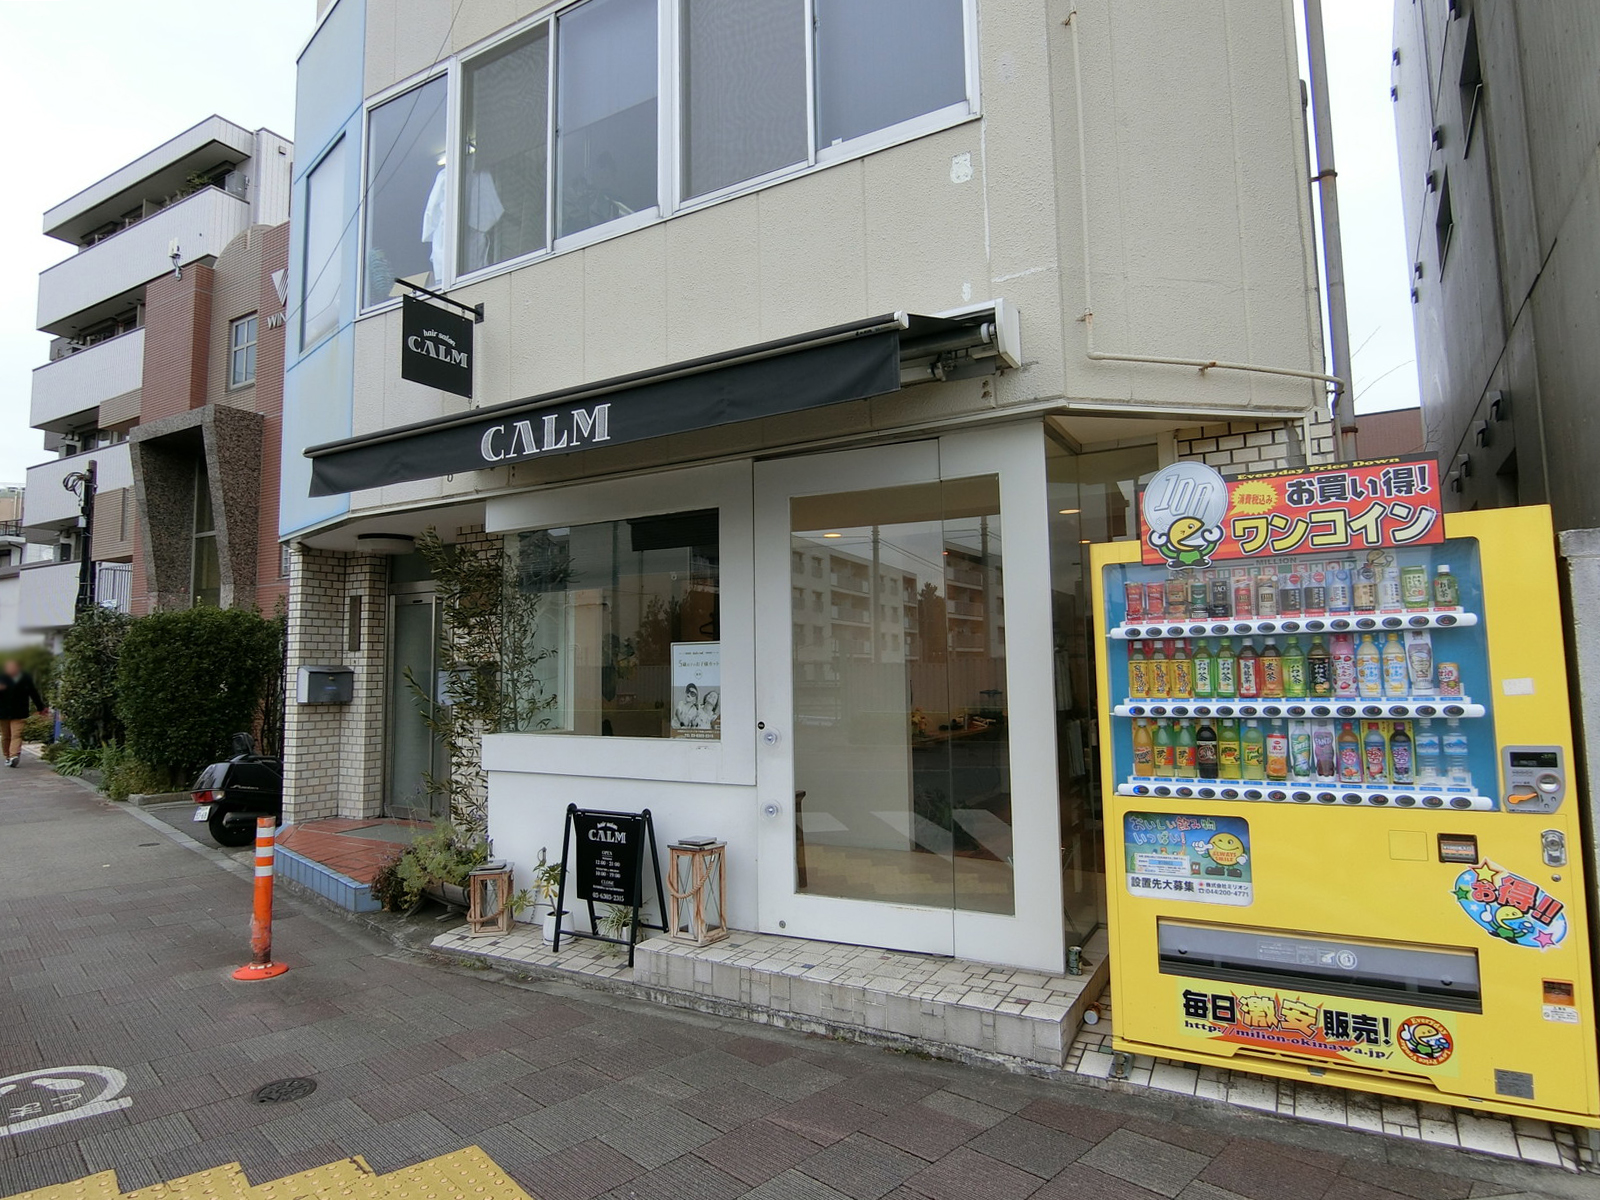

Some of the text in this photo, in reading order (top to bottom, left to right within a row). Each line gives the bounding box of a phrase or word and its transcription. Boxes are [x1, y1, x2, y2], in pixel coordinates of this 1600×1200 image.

[423, 329, 456, 347] hair salon
[407, 335, 468, 369] CALM
[480, 402, 612, 462] CALM
[1237, 456, 1401, 480] Everyday Price Down
[1285, 463, 1432, 507] お買い得!
[1154, 473, 1215, 520] 100
[1237, 493, 1273, 505] 消費税込み
[1231, 500, 1437, 556] ワンコイン
[1205, 561, 1356, 579] SUPER SHOP
[1256, 556, 1297, 566] MILLION
[1197, 662, 1208, 682] お茶
[1221, 662, 1232, 682] お茶
[1265, 662, 1277, 682] 麦茶
[1290, 664, 1303, 684] お茶
[1313, 663, 1327, 683] お茶
[1129, 815, 1217, 832] おいしい飲み物
[588, 829, 627, 844] CALM
[1133, 830, 1187, 846] いっぱい!
[1130, 876, 1195, 893] 設置先大募集
[1205, 882, 1250, 891] 株式会社ミリオン
[1470, 876, 1564, 927] お得!!
[1182, 988, 1393, 1046] 毎日激安販売!
[1410, 1017, 1448, 1035] Everyday
